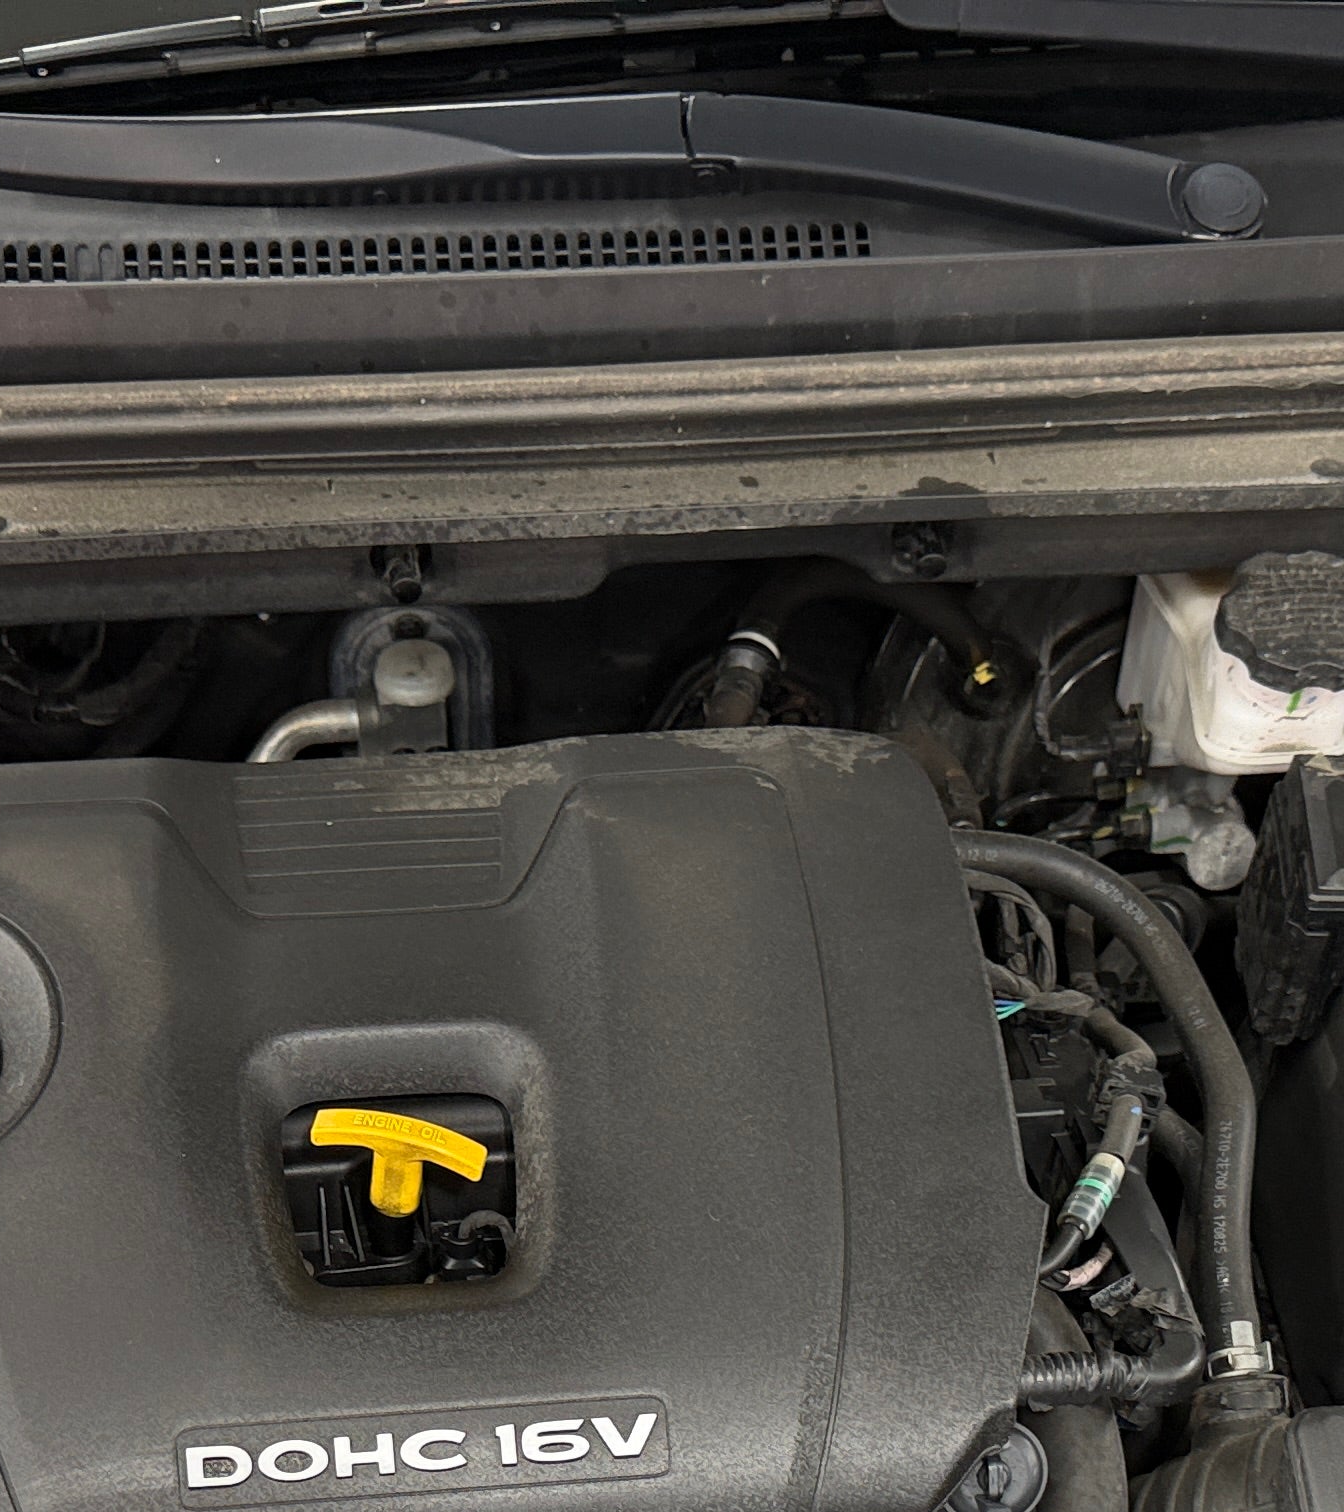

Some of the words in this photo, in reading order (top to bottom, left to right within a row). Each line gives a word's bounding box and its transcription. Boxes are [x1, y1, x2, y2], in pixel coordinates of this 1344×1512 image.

[352, 1113, 413, 1134] ENGINE
[421, 1126, 447, 1145] OIL
[185, 1428, 468, 1488] DOHC
[495, 1413, 658, 1467] 16V
